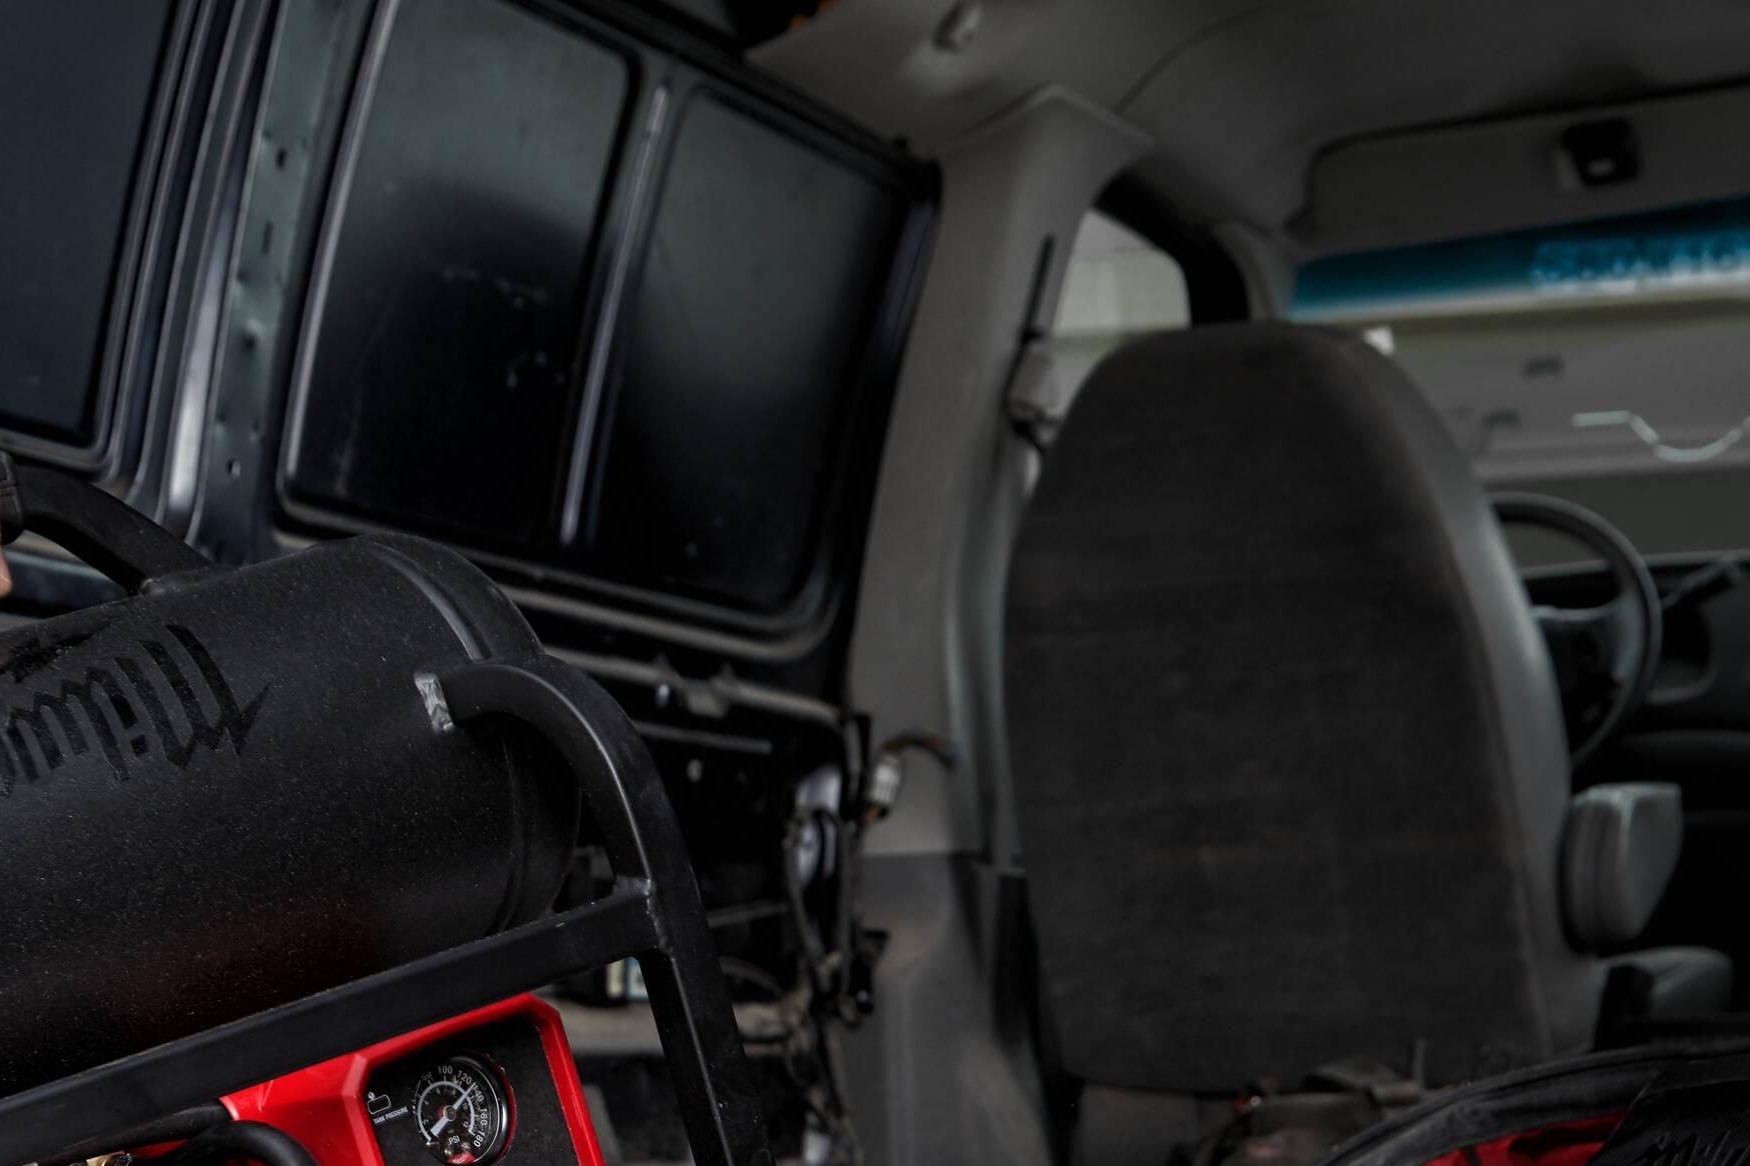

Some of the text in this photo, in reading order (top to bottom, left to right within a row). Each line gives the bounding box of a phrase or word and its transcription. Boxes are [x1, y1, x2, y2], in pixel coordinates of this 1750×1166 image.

[437, 1065, 454, 1074] 100
[457, 1069, 472, 1085] 120
[479, 1108, 488, 1126] 160
[473, 1130, 486, 1148] 180
